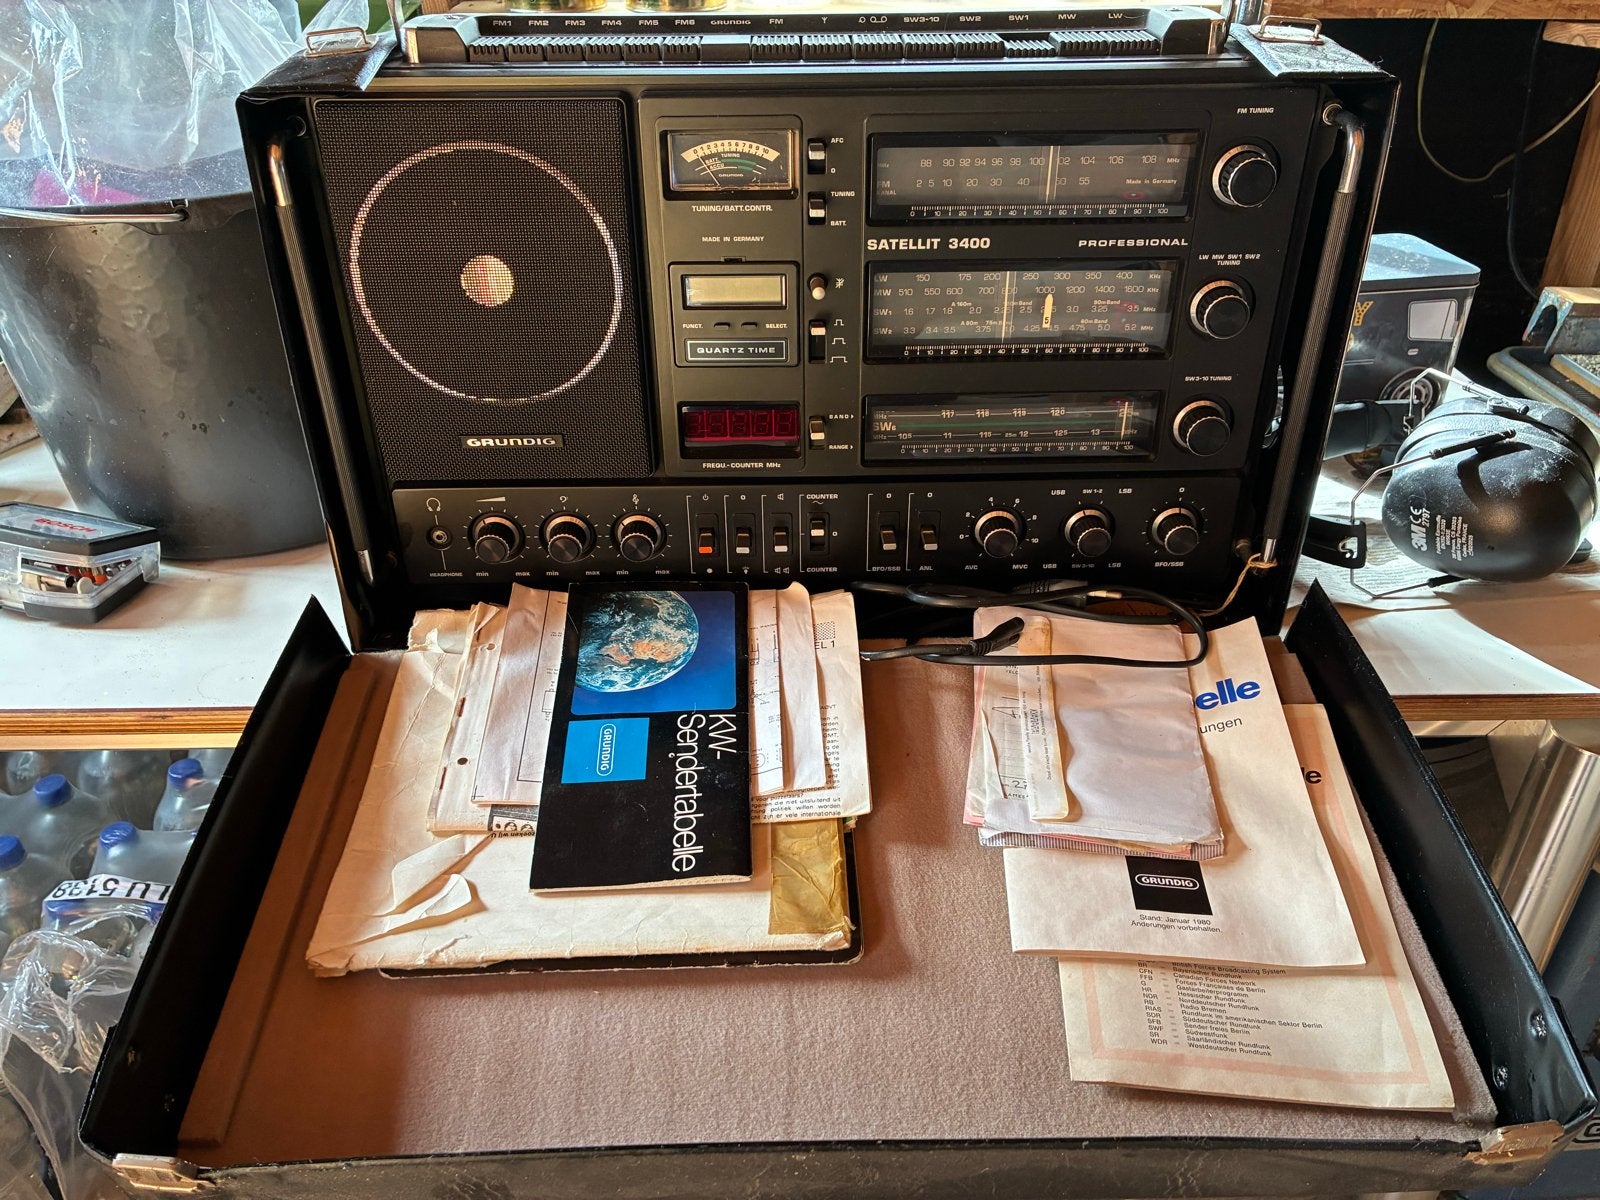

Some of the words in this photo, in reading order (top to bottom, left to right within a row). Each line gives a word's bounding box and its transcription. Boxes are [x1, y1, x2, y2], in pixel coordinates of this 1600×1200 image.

[992, 158, 1002, 166] 96
[1010, 158, 1021, 166] 98
[1108, 156, 1124, 164] 106
[1079, 177, 1090, 185] 55
[867, 239, 940, 250] SATELLIT
[949, 238, 990, 249] 3400
[1079, 239, 1188, 247] PROFESSIONAL
[899, 288, 913, 296] 510
[467, 438, 555, 447] GRUNDIG
[1422, 508, 1430, 527] 2797
[34, 518, 97, 532] BOSCH
[1411, 524, 1427, 551] 3M
[1200, 717, 1242, 734] ungen
[709, 714, 736, 759] KW-
[600, 728, 612, 771] GRUNDIG
[671, 714, 706, 872] Sendertabelle
[1141, 877, 1193, 887] GRUNDIG
[1139, 914, 1163, 922] Stand:
[1165, 916, 1190, 924] Januar
